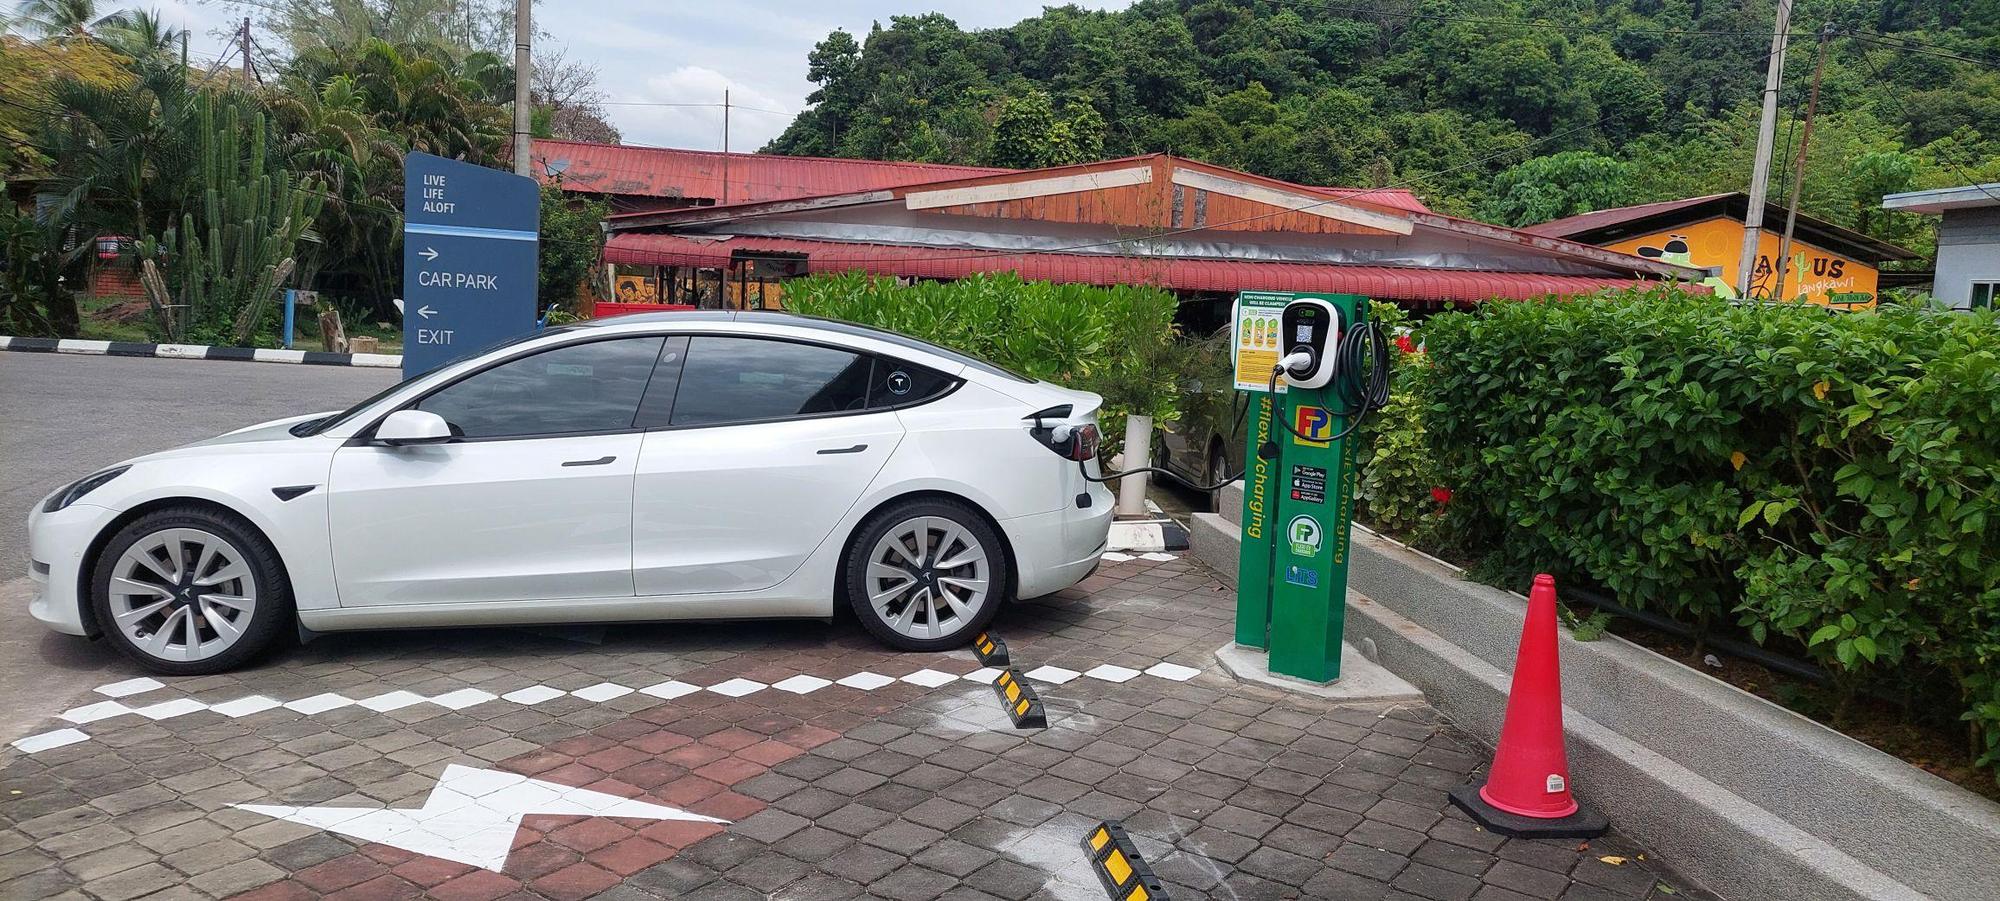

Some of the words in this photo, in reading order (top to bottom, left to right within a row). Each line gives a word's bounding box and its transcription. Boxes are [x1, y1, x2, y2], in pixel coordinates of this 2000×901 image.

[423, 174, 446, 187] LIVE
[423, 187, 444, 200] LIFE
[423, 201, 456, 214] ALOFT
[418, 271, 452, 288] CAR
[455, 273, 498, 290] PARK
[417, 329, 454, 345] EXIT
[1301, 469, 1316, 477] Google
[1300, 494, 1324, 503] AppGallery
